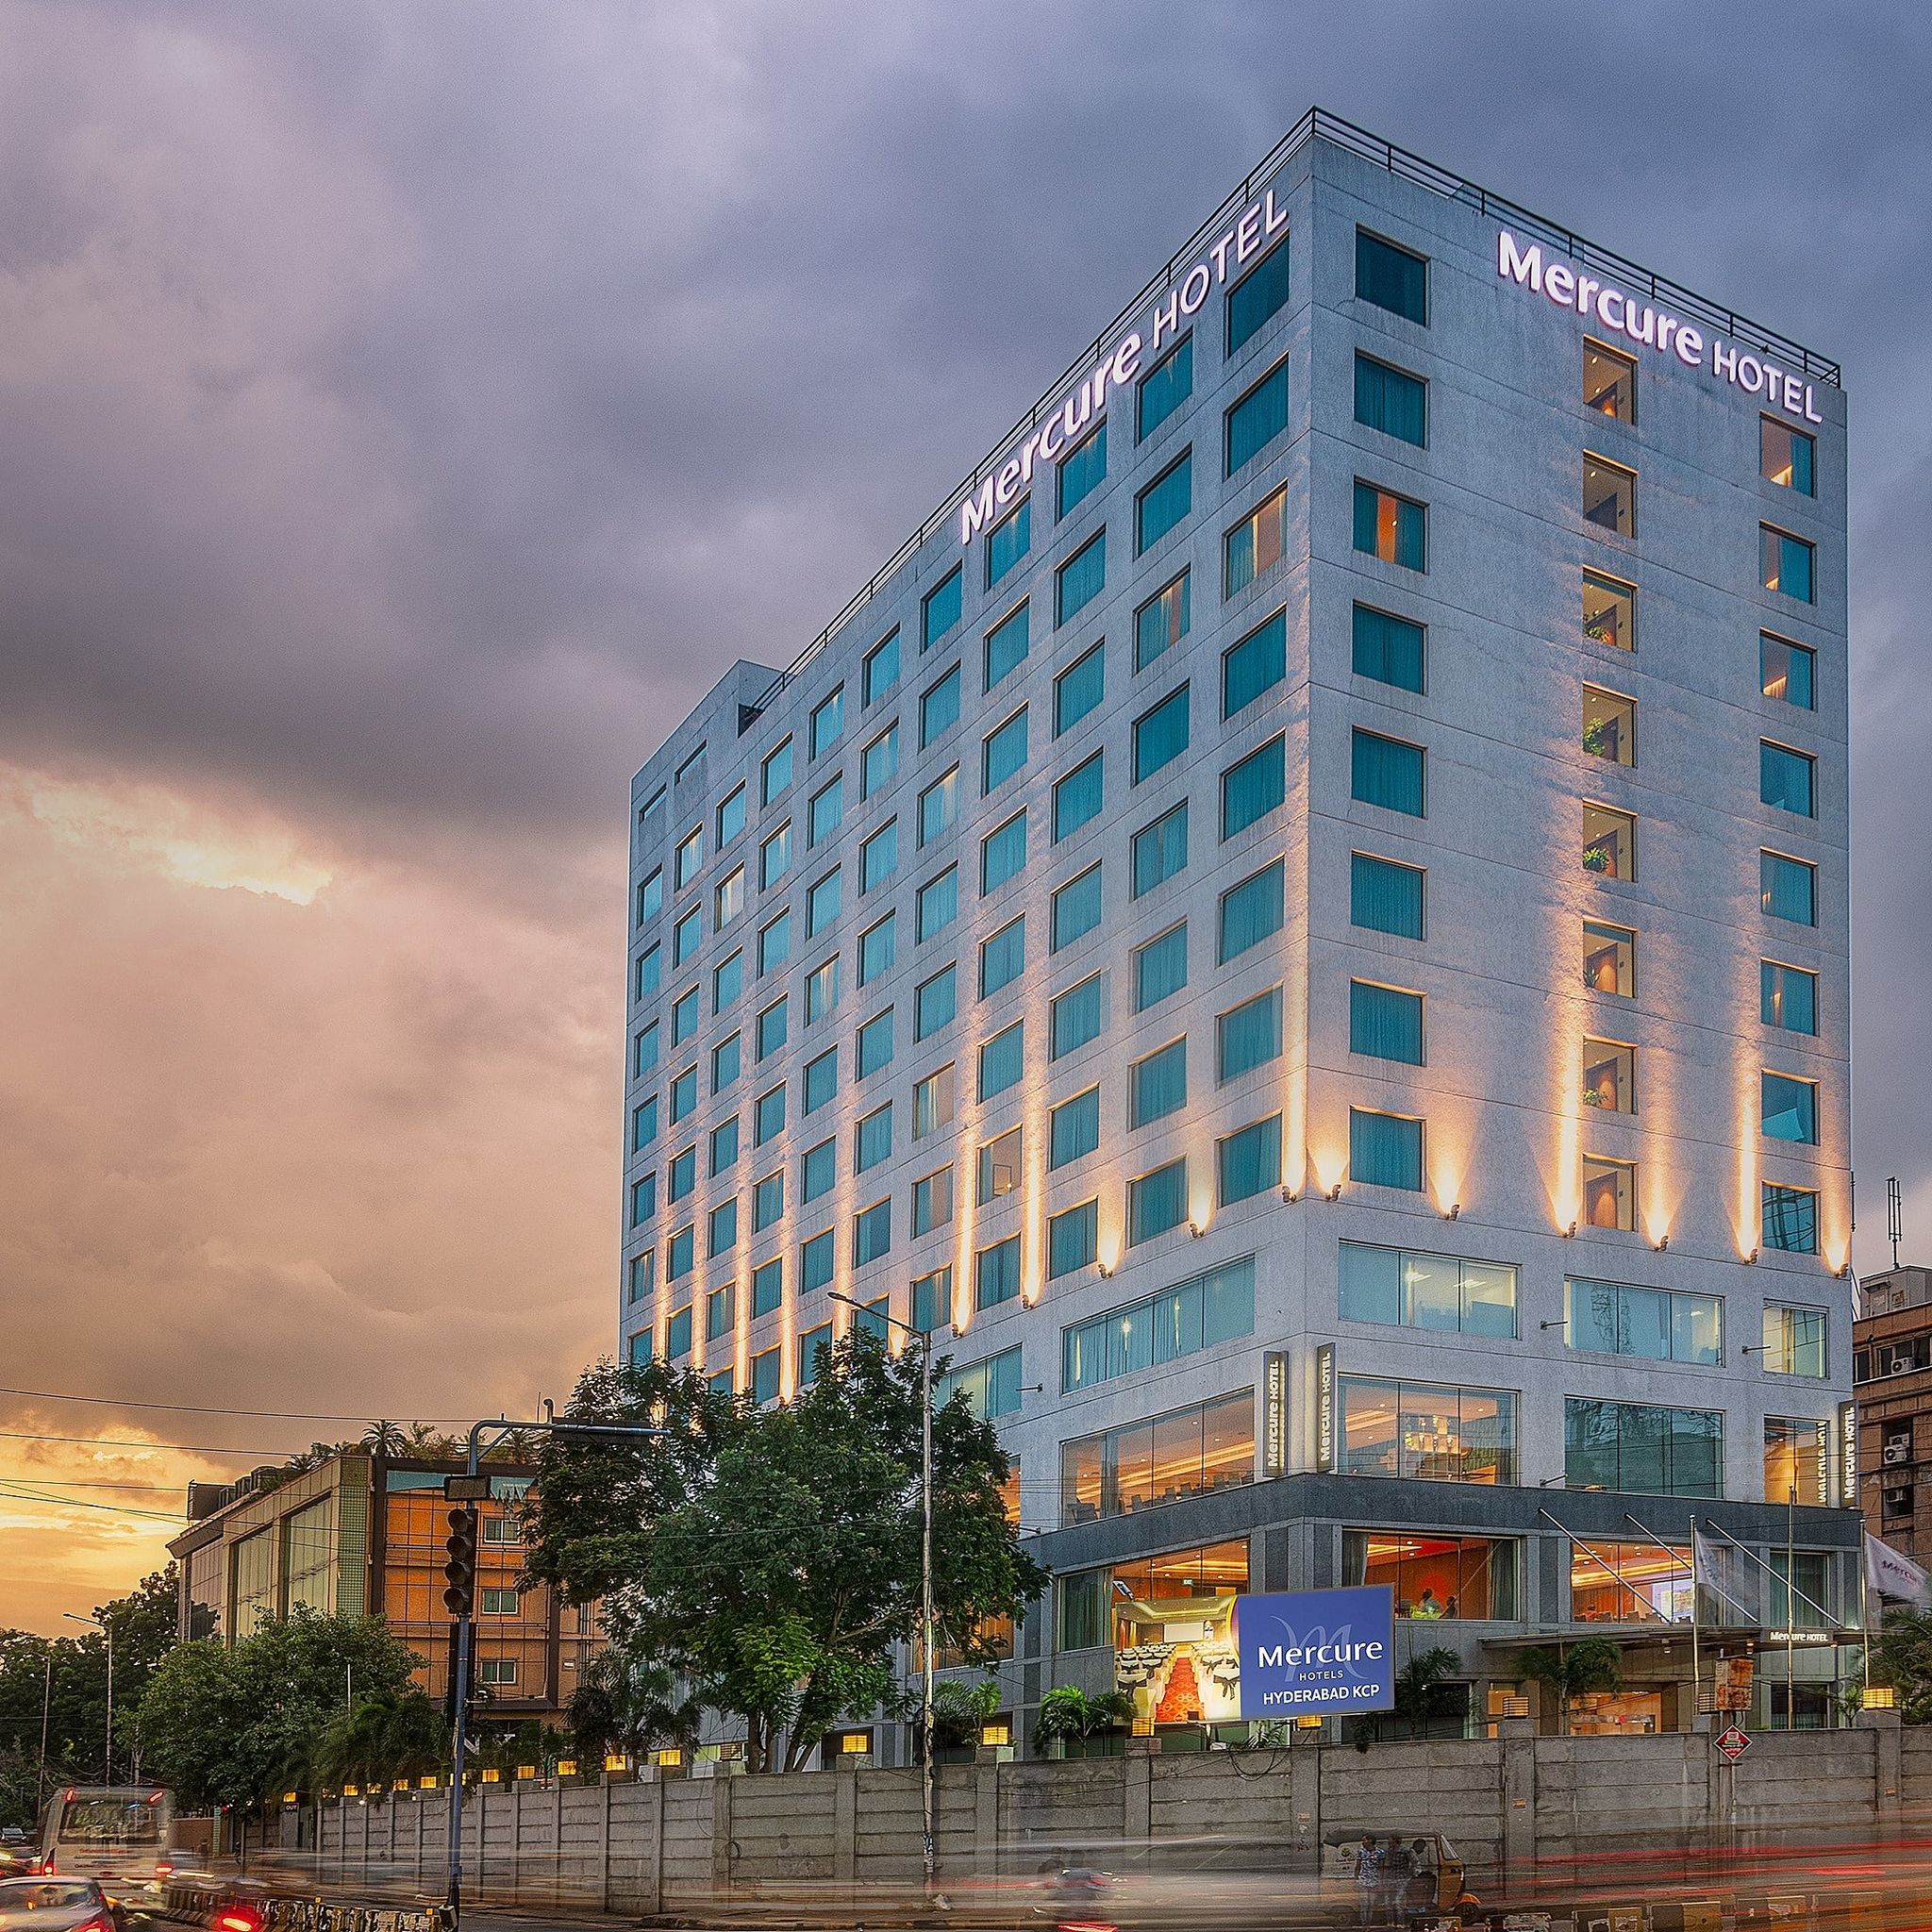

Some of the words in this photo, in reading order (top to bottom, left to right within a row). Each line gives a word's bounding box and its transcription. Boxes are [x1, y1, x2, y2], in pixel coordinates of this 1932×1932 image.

[1498, 230, 1705, 365] Mercure
[1712, 340, 1824, 423] HOTEL
[961, 333, 1141, 545] Mercure
[1153, 189, 1289, 349] HOTEL
[1269, 1360, 1279, 1400] HOTEL
[1322, 1352, 1331, 1393] HOTEL
[1268, 1401, 1279, 1467] Mercure
[1320, 1394, 1331, 1462] Mercure
[1844, 1442, 1856, 1499] Mercure
[1258, 1641, 1383, 1668] Mercure
[1770, 1631, 1807, 1641] Merure
[1806, 1633, 1829, 1642] HOTEL
[1263, 1686, 1350, 1706] HYDERABAD
[1353, 1684, 1380, 1698] KCP
[1299, 1670, 1343, 1681] HOTELS
